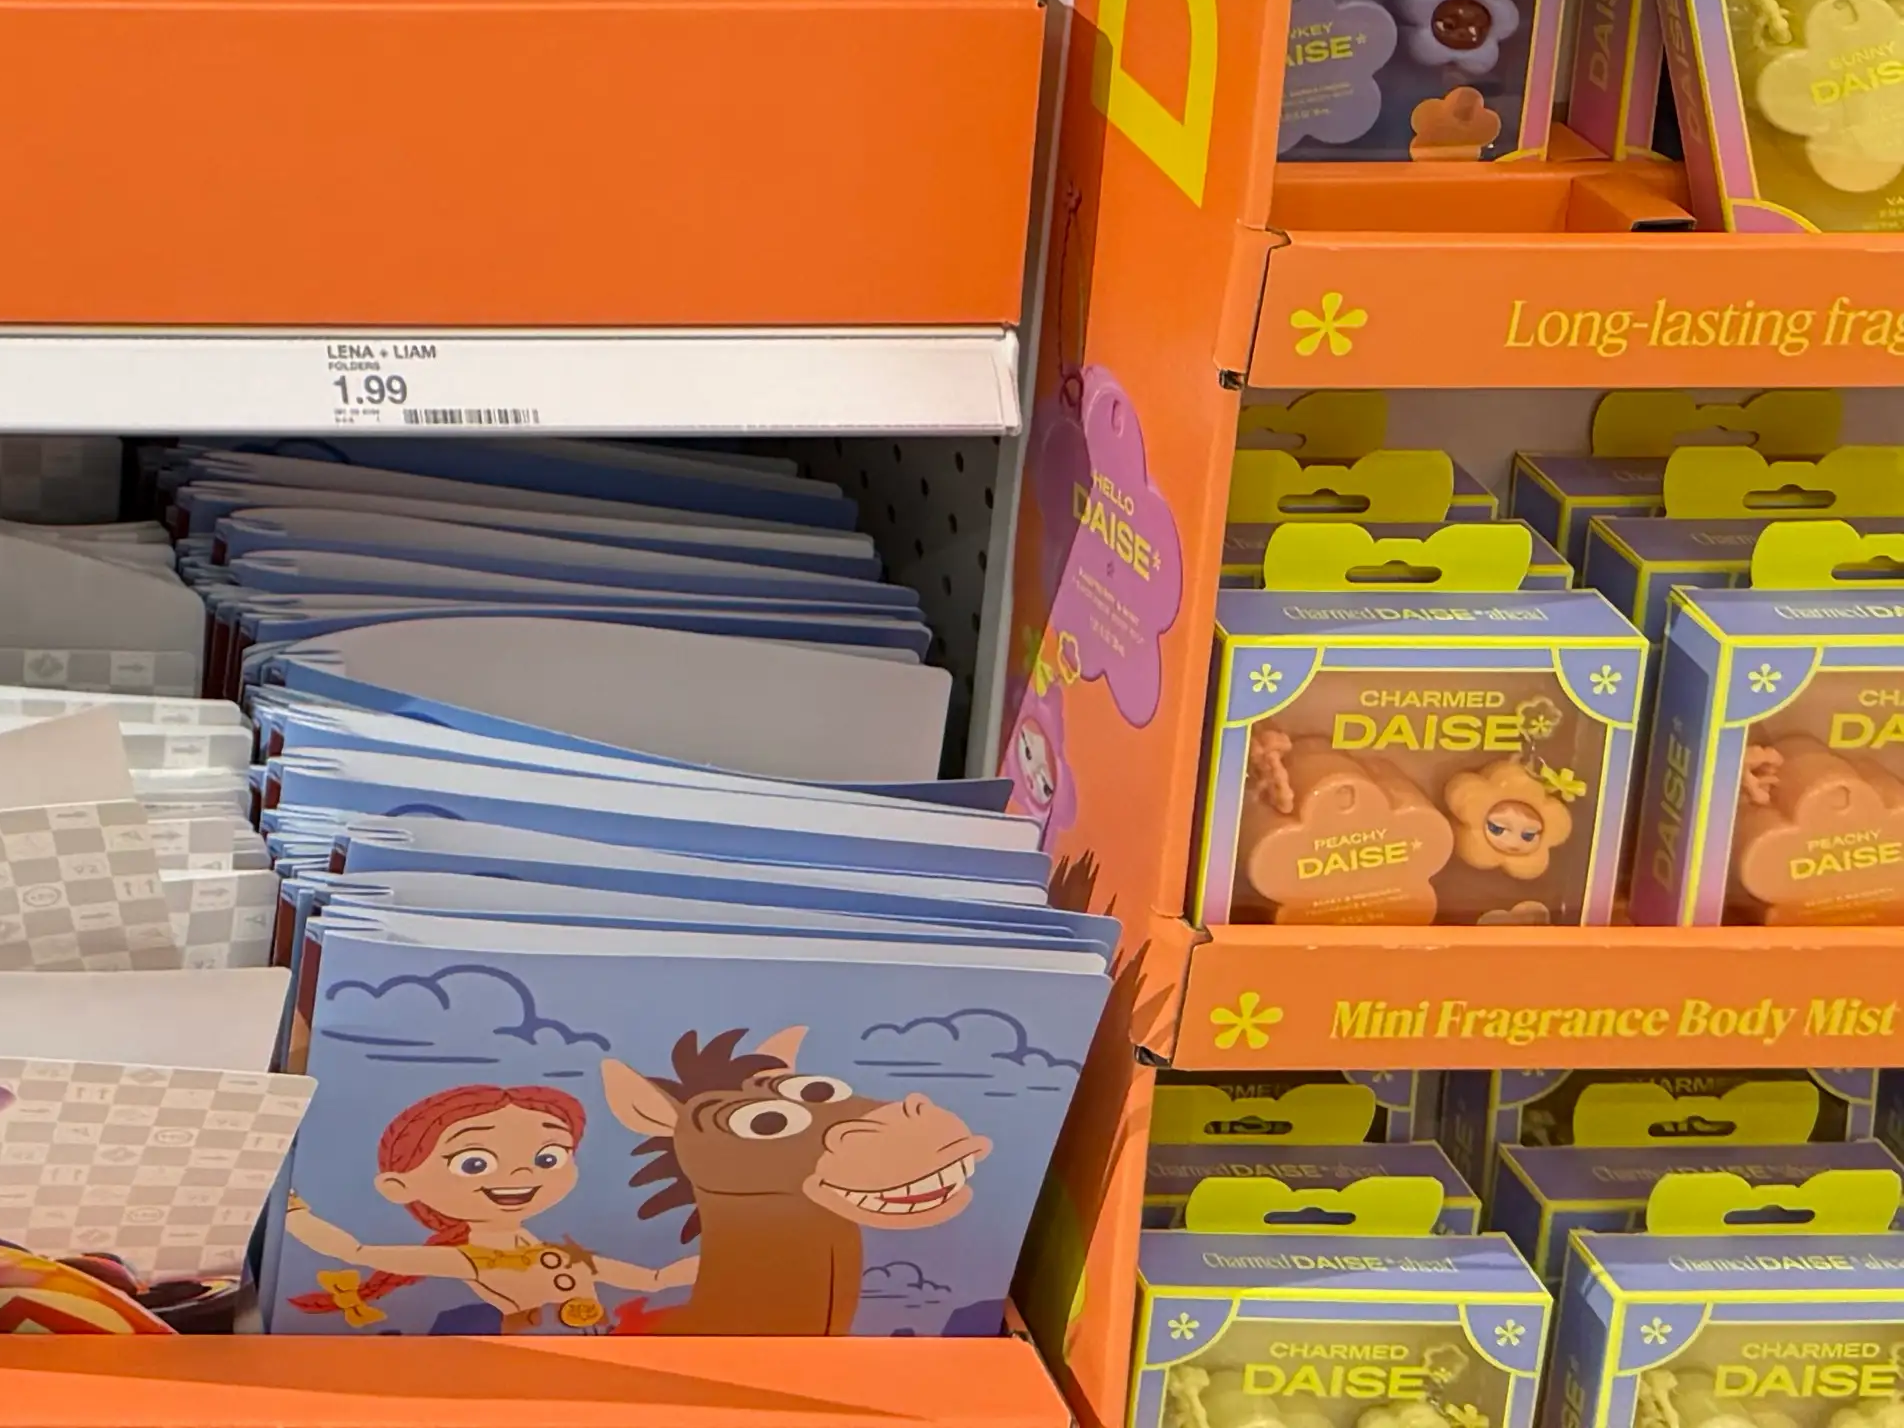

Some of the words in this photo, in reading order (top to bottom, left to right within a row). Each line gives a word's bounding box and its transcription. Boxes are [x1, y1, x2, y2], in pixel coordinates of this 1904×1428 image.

[1504, 298, 1817, 357] Long-lasting
[327, 345, 374, 359] LENA
[394, 345, 436, 359] LIAM
[333, 375, 407, 404] 1.99
[1091, 469, 1135, 517] HELLO
[1283, 606, 1376, 621] Charmed
[1359, 690, 1505, 709] CHARMED
[1332, 713, 1523, 751] DAISE
[1314, 828, 1389, 851] PEACHY
[1807, 829, 1882, 852] PEACHY
[1297, 841, 1409, 880] DAISE
[1330, 1000, 1429, 1040] Mini
[1434, 1000, 1669, 1046] Fragrance
[1677, 999, 1796, 1045] Body
[1804, 997, 1900, 1037] Mist
[1203, 1252, 1292, 1271] Charmed
[1668, 1255, 1758, 1272] Charmed
[1268, 1343, 1409, 1362] CHARMED
[1741, 1342, 1881, 1360] CHARMED
[1242, 1366, 1425, 1400] DAISE
[1714, 1364, 1898, 1399] DAISE
